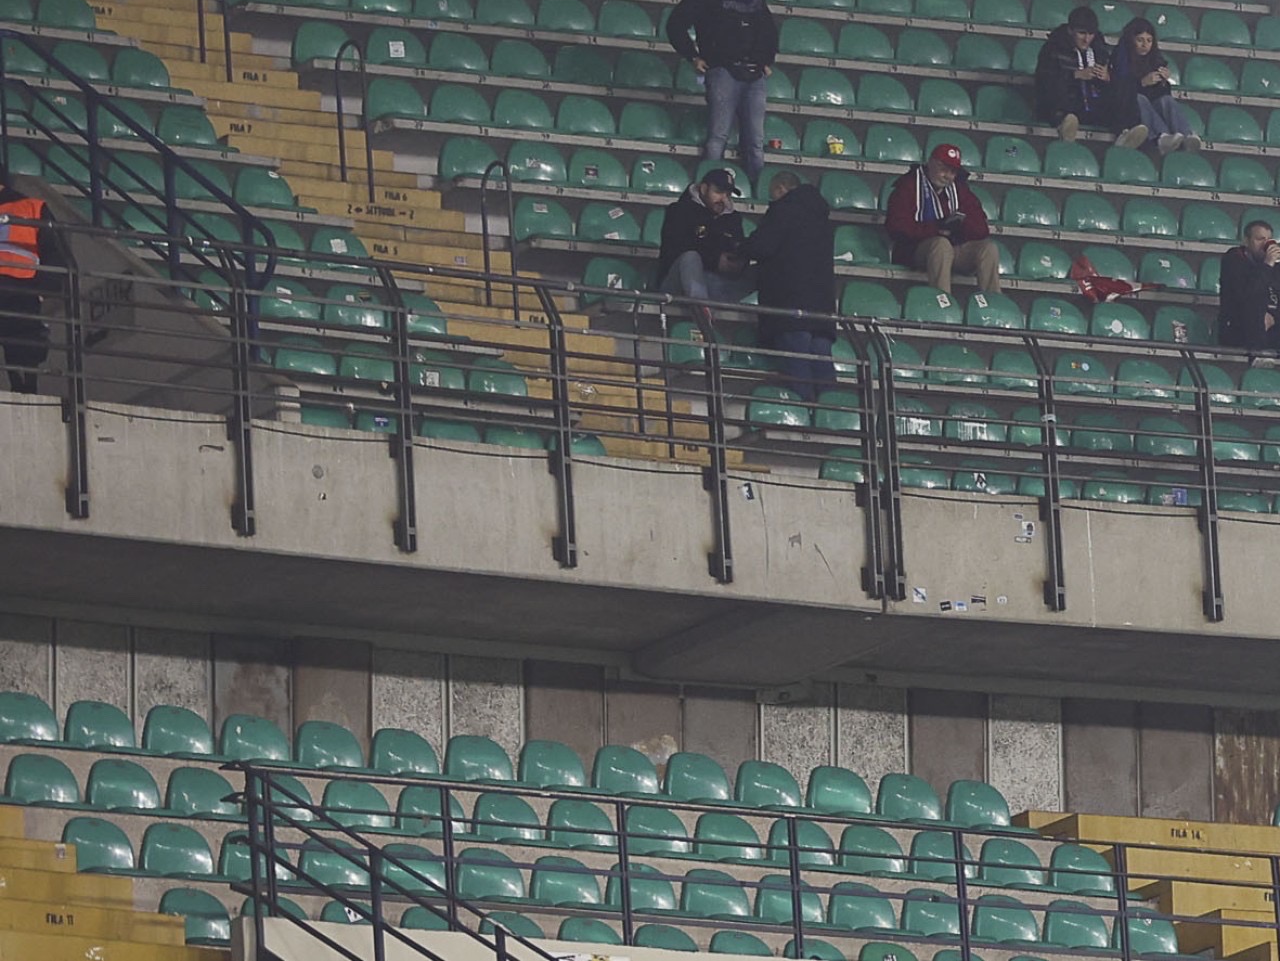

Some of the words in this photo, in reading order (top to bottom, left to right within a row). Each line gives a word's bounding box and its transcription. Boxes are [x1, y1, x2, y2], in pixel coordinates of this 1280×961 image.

[243, 71, 259, 82] FILA
[229, 123, 245, 133] FILA
[385, 191, 401, 201] FILA
[373, 243, 389, 254] FILA
[1171, 827, 1188, 839] FILA
[1191, 828, 1201, 840] 14
[46, 913, 64, 925] FILA
